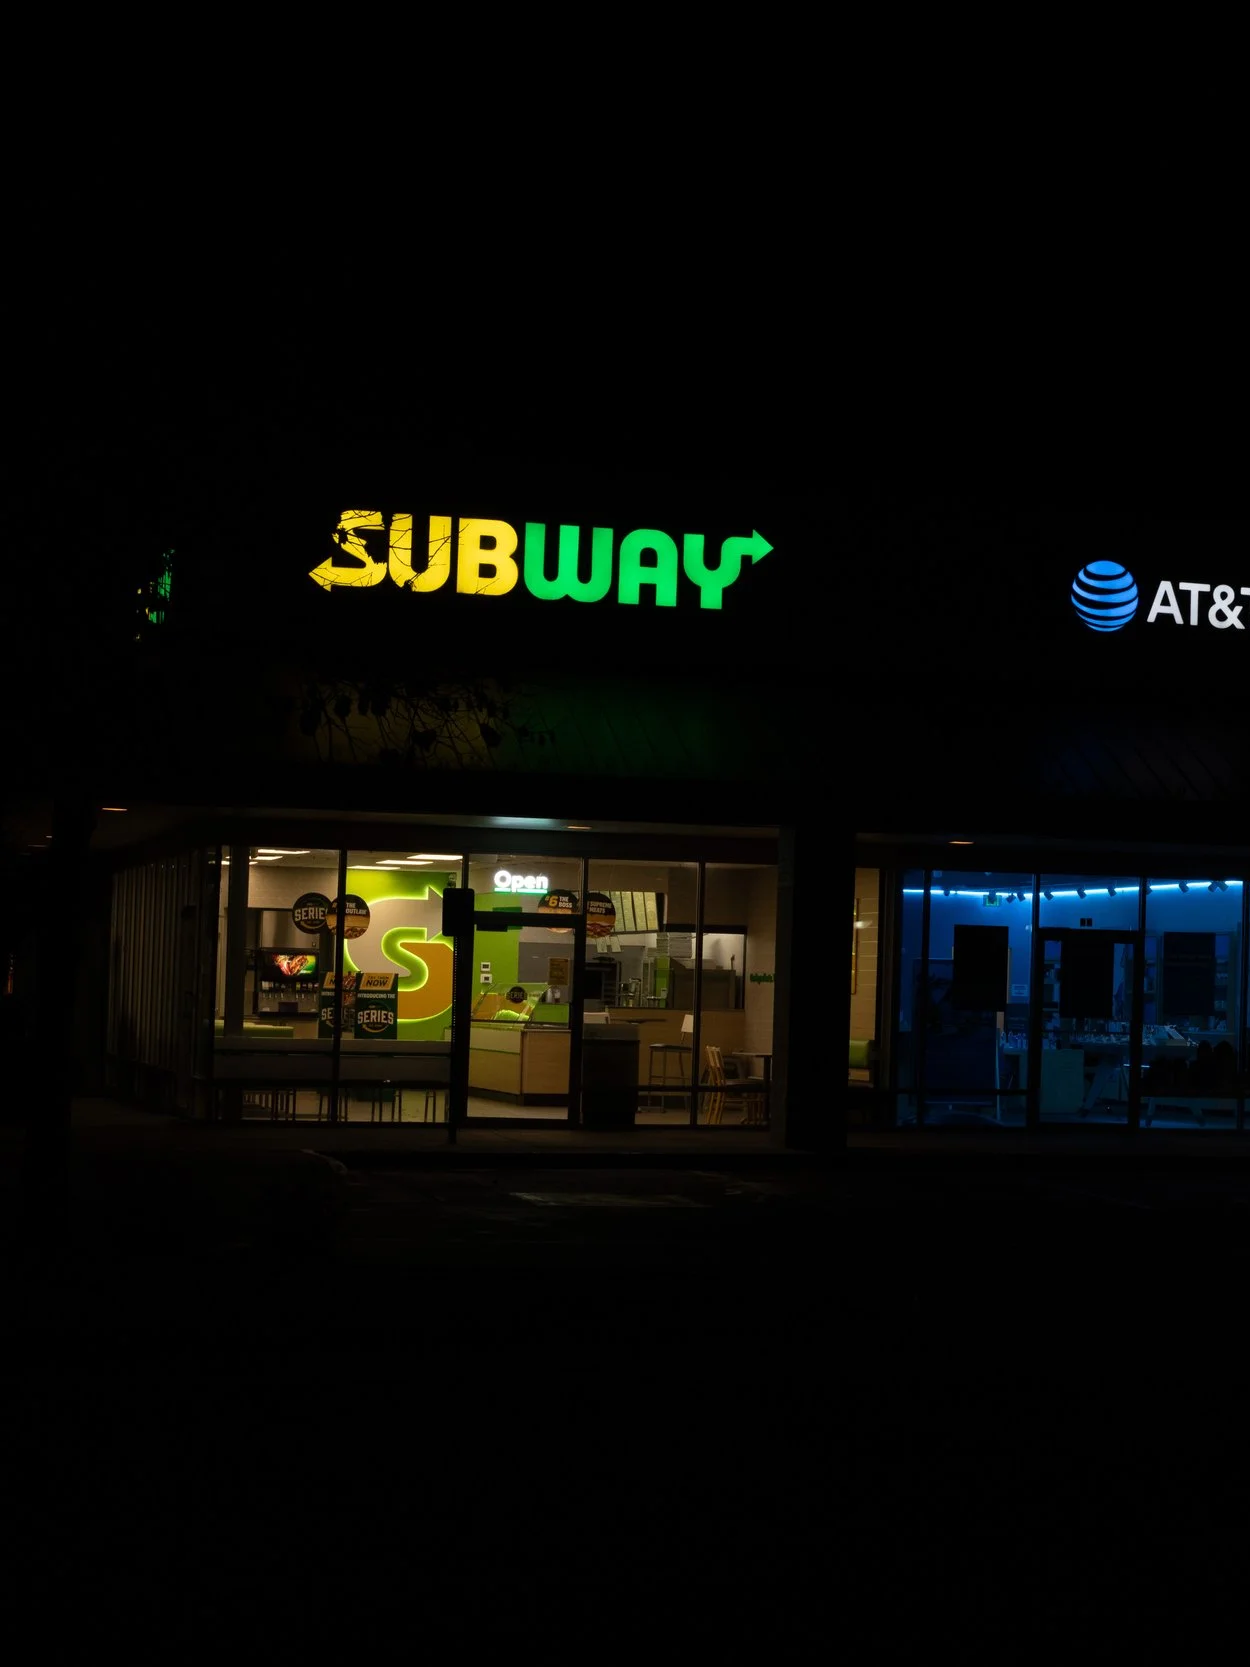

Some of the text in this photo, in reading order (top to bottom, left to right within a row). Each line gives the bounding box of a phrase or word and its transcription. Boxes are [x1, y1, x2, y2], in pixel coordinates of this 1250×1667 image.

[308, 510, 774, 609] SUBWAY
[494, 870, 549, 893] Open
[366, 979, 389, 987] NOW
[357, 1009, 394, 1025] SERIES
